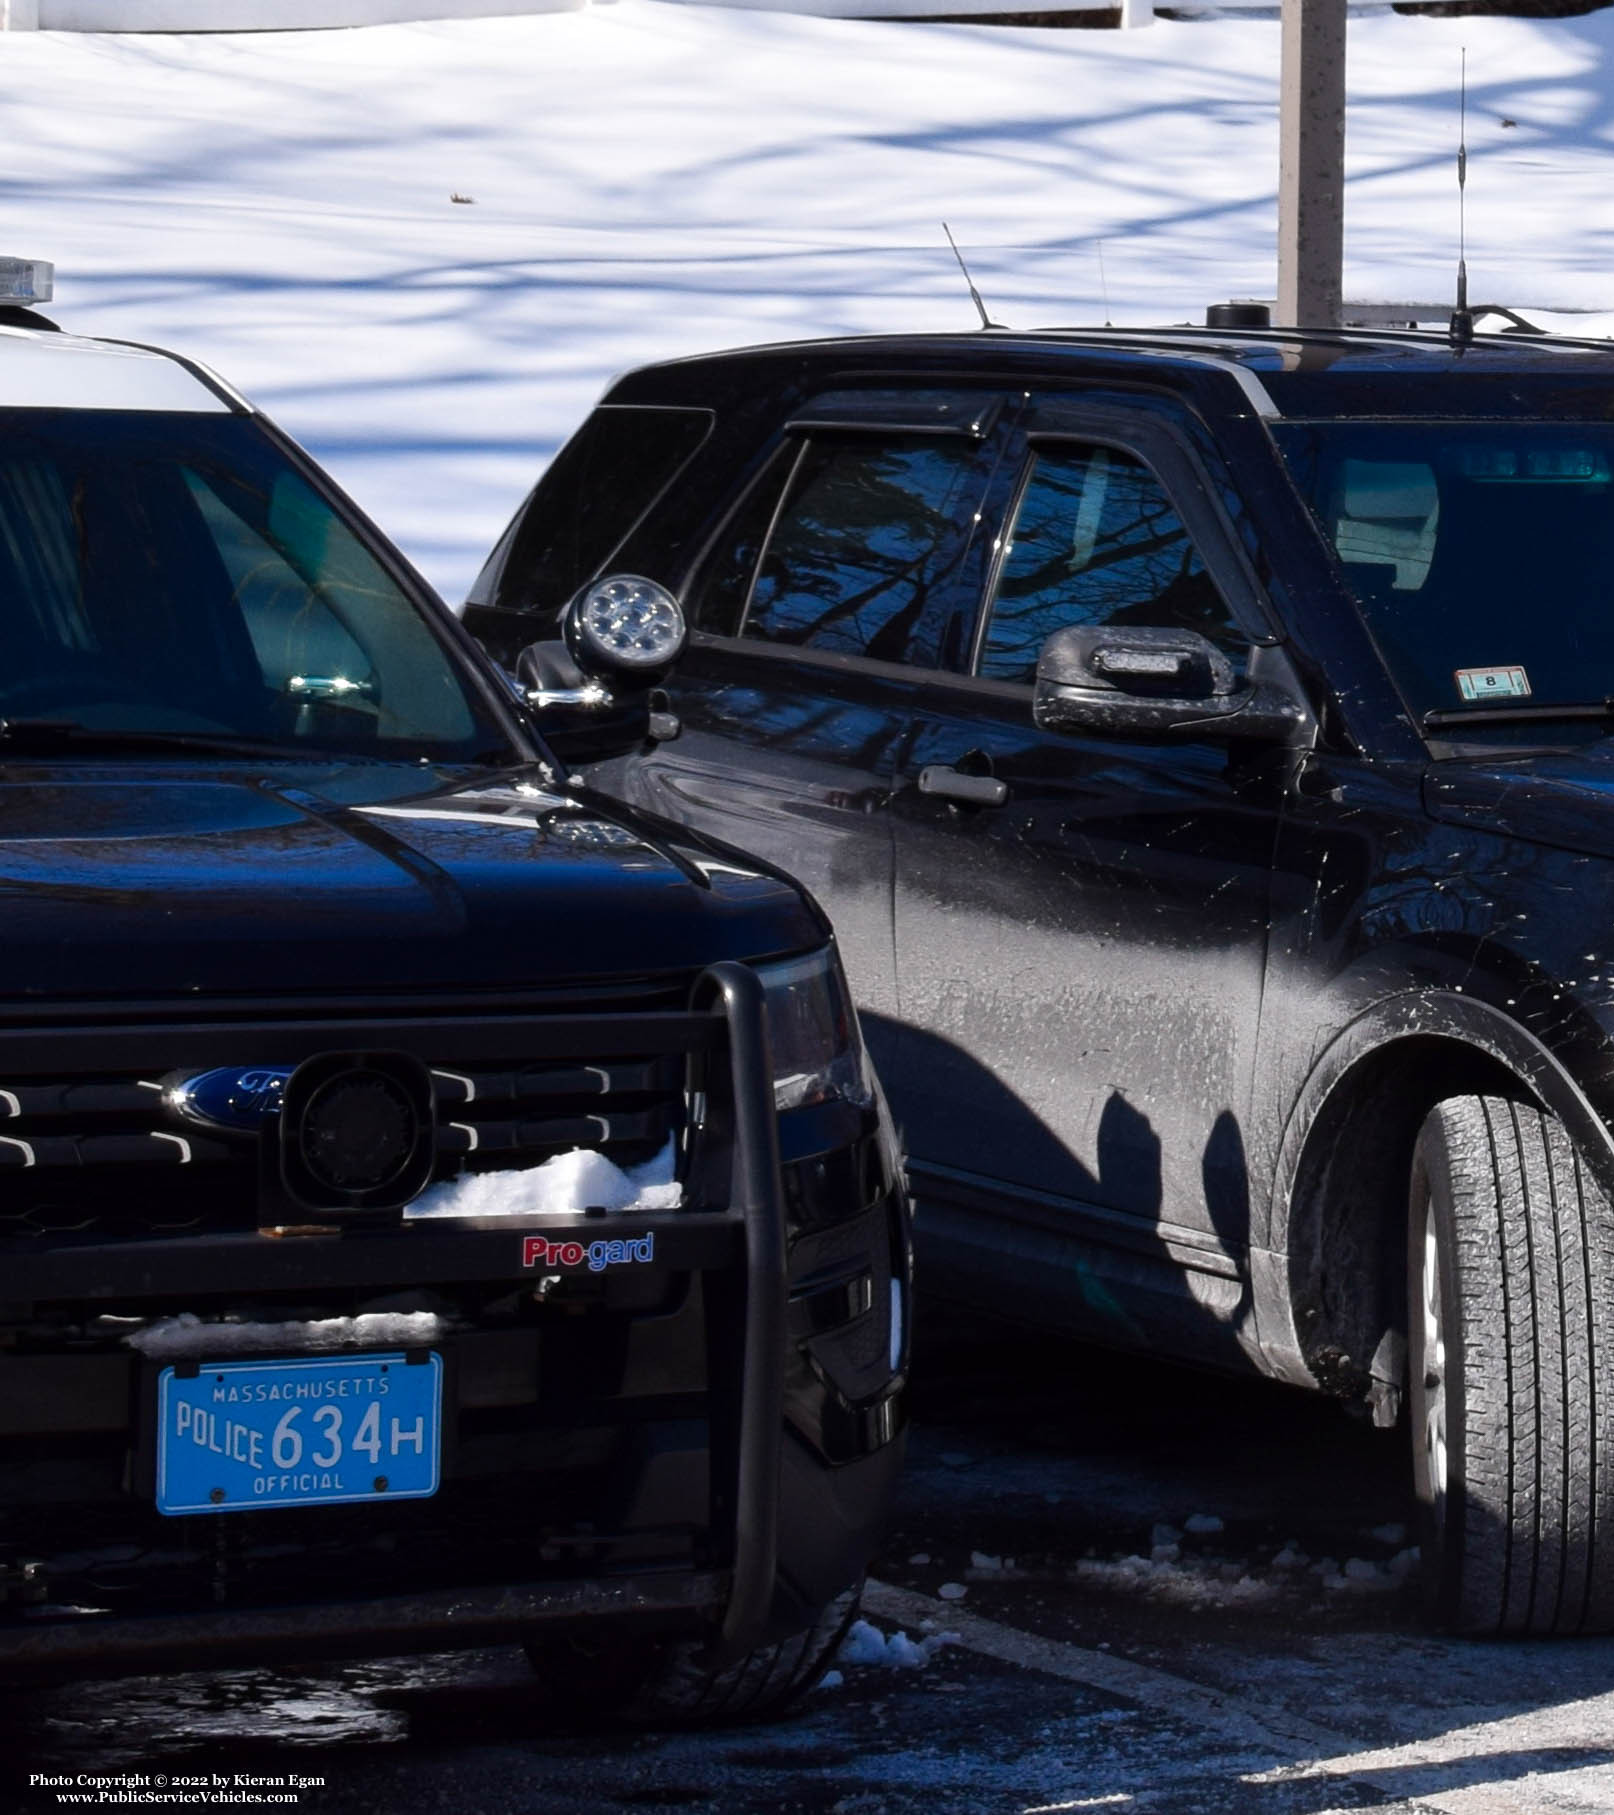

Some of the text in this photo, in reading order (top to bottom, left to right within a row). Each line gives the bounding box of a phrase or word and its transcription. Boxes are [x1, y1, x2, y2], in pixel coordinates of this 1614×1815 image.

[1485, 676, 1496, 686] 8
[523, 1232, 653, 1271] Pro-gard
[213, 1378, 389, 1402] MASSACHUSETTS
[177, 1401, 424, 1469] POLICE 634H
[254, 1473, 344, 1494] OFFICIAL
